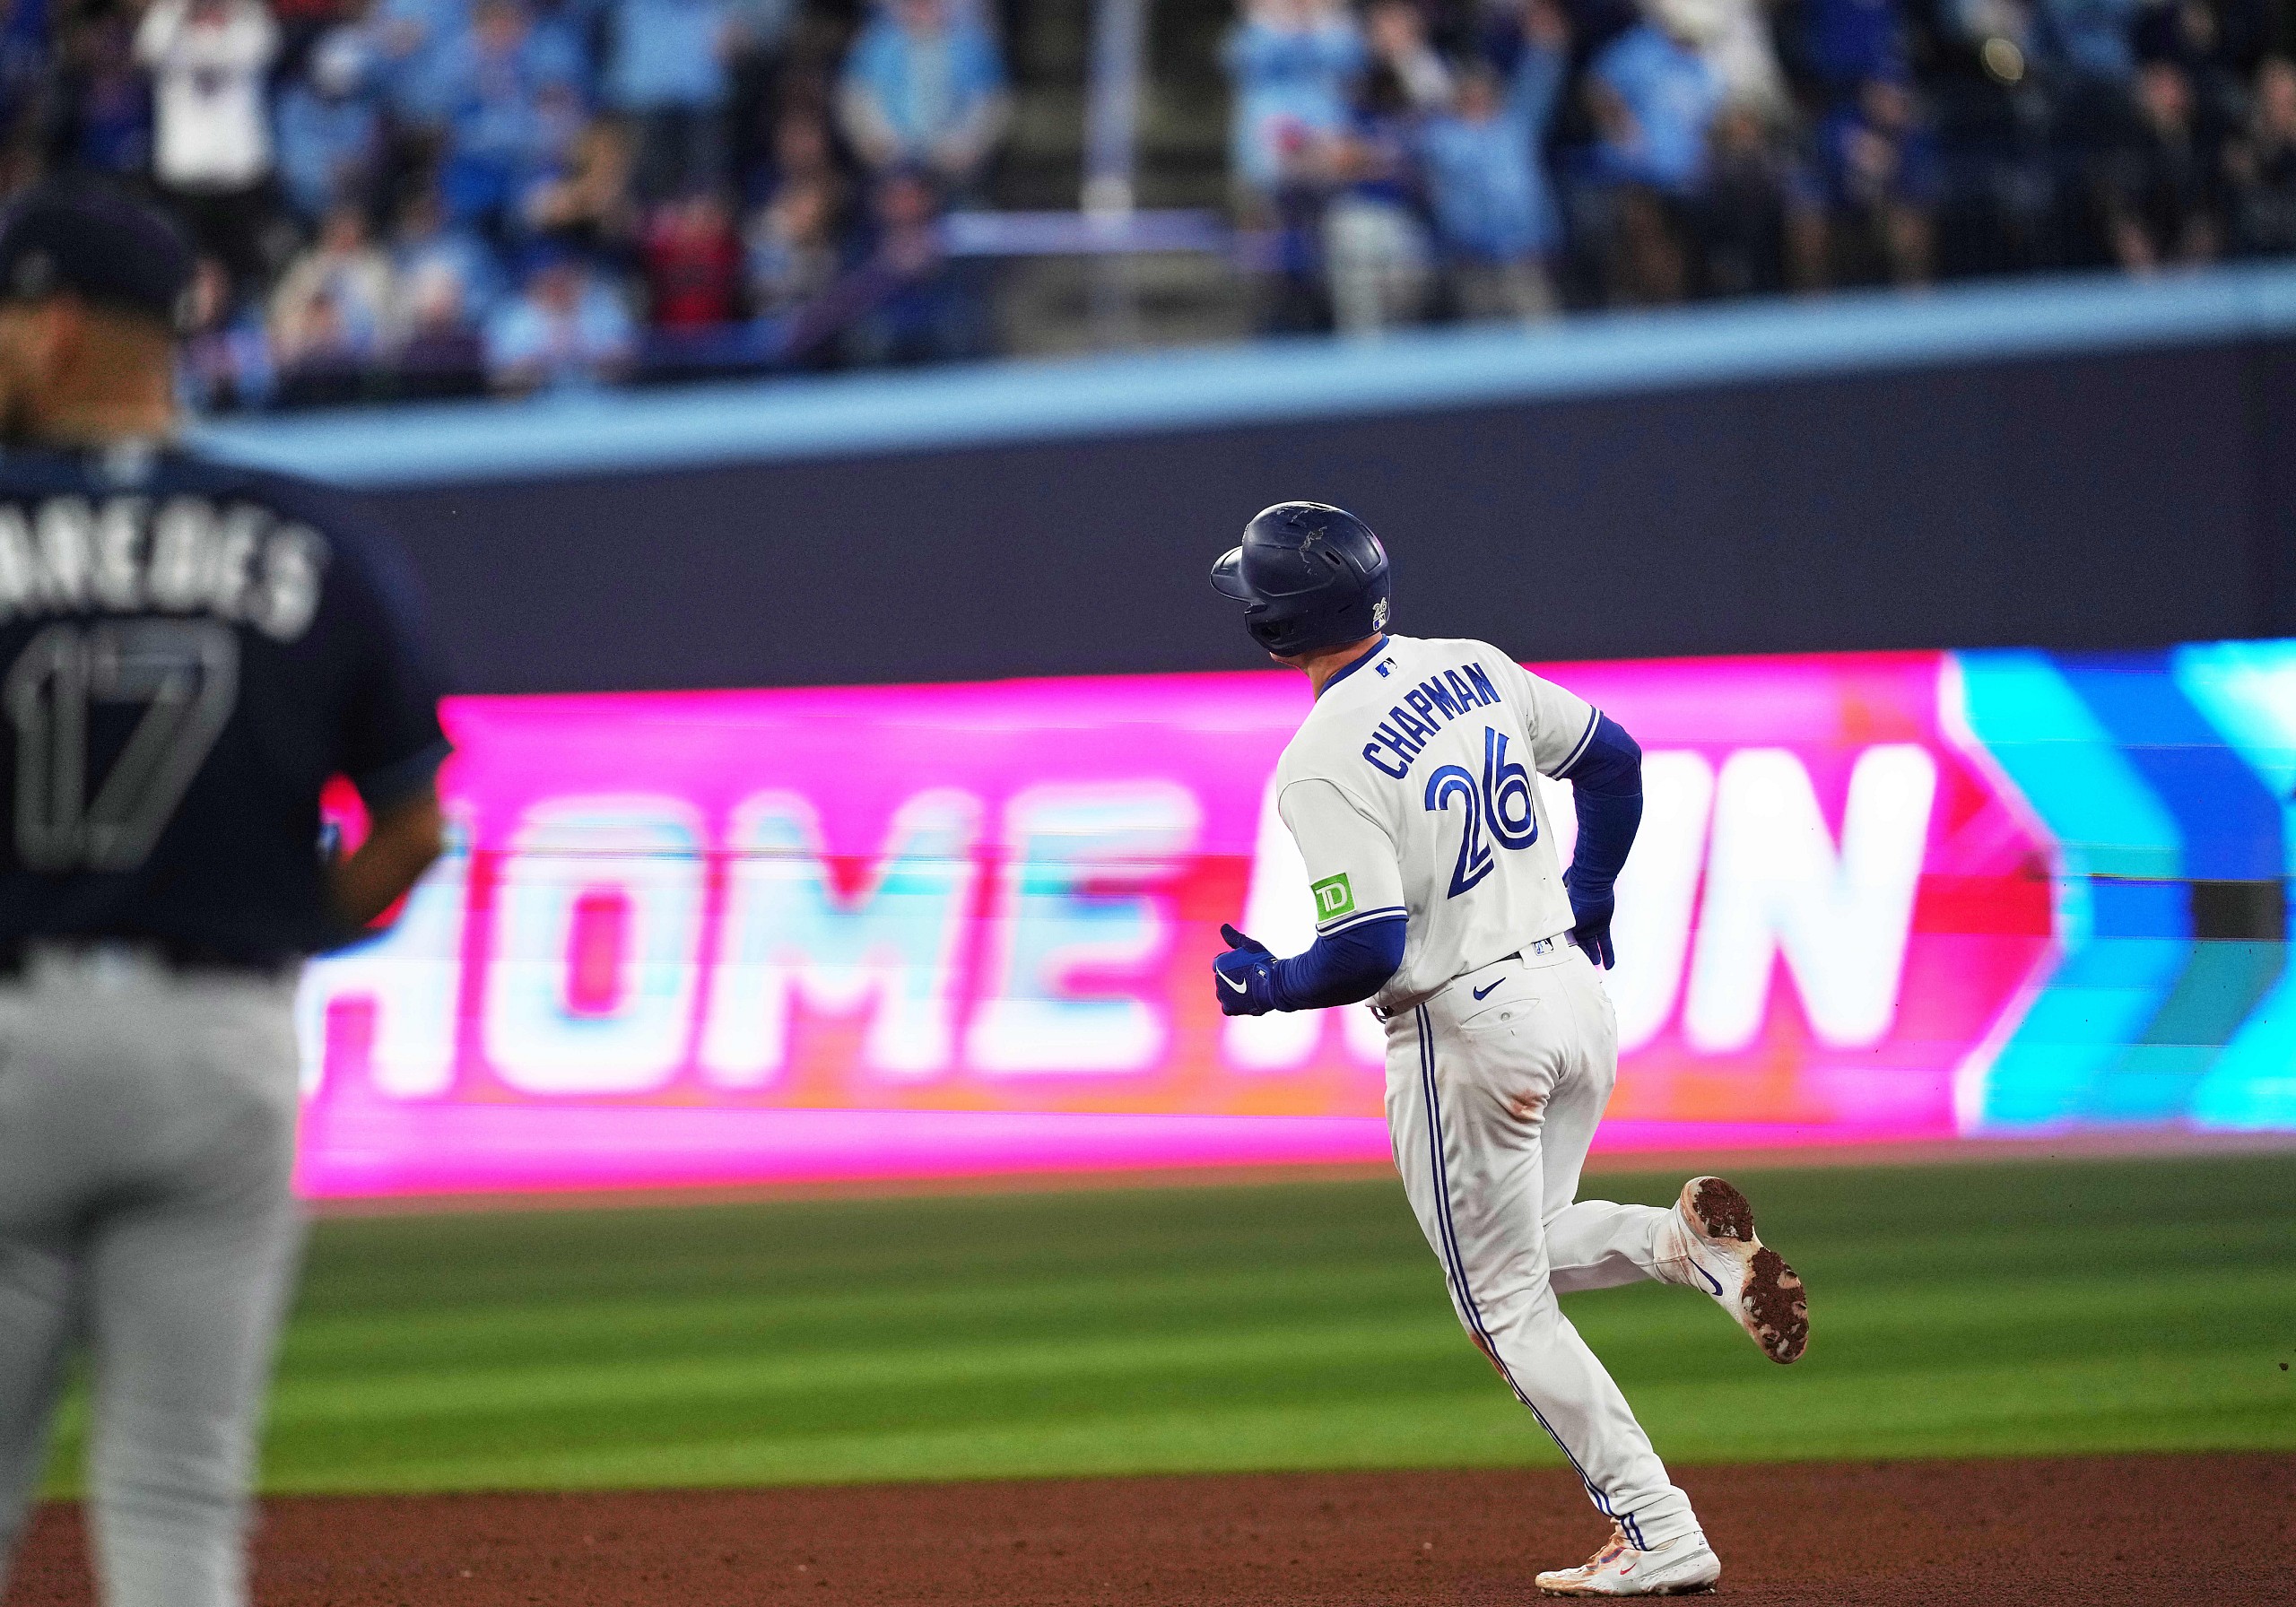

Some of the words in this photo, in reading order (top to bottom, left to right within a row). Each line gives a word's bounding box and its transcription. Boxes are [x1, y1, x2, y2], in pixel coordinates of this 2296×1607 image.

[1372, 596, 1387, 620] 26
[5, 621, 242, 870] 17
[1362, 663, 1501, 779] CHAPMAN
[1425, 726, 1538, 899] 26
[1316, 882, 1347, 912] TD
